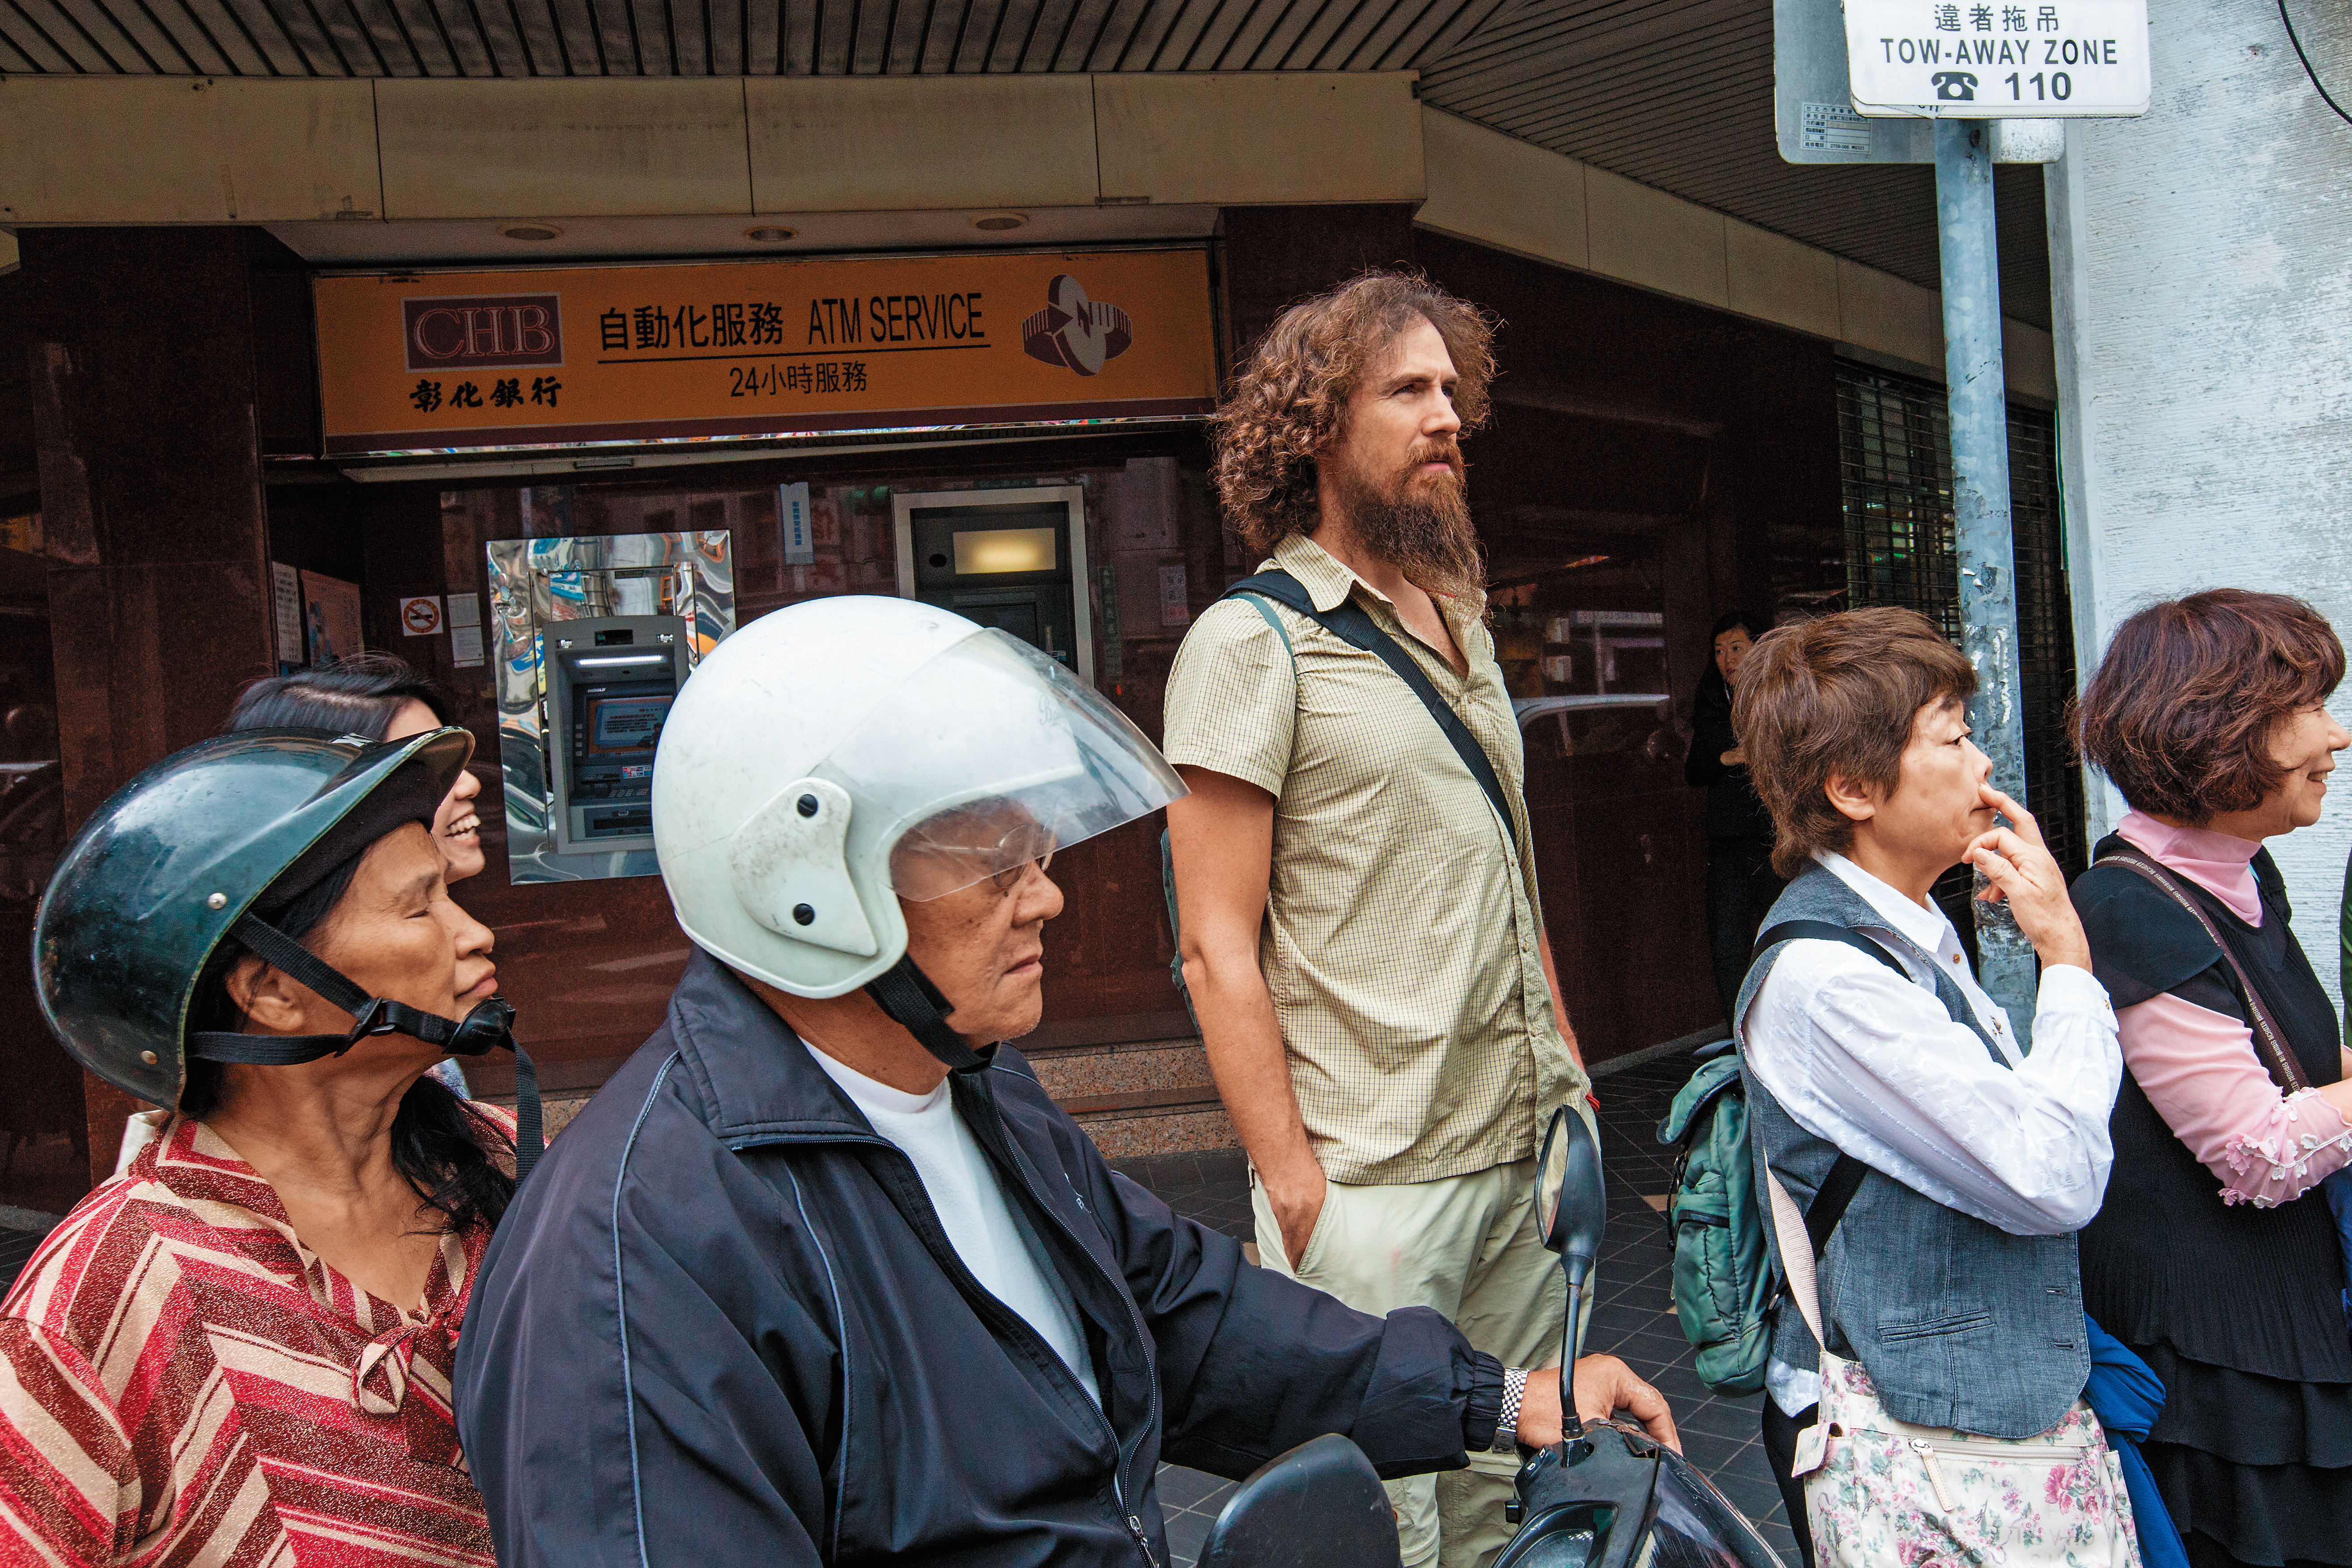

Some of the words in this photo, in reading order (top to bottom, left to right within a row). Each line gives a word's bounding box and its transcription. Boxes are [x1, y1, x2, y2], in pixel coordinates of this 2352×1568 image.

[1934, 3, 2059, 32] 違者拖吊
[1880, 38, 2030, 64] TOW-AWAY
[2044, 39, 2118, 64] ZONE
[2005, 72, 2071, 101] 110
[414, 305, 554, 358] CHB
[600, 302, 783, 351] 自動化服務
[808, 297, 861, 345] ATM
[870, 293, 984, 343] SERVICE
[409, 376, 562, 412] 彰化銀行
[729, 361, 868, 397] 24小時服務
